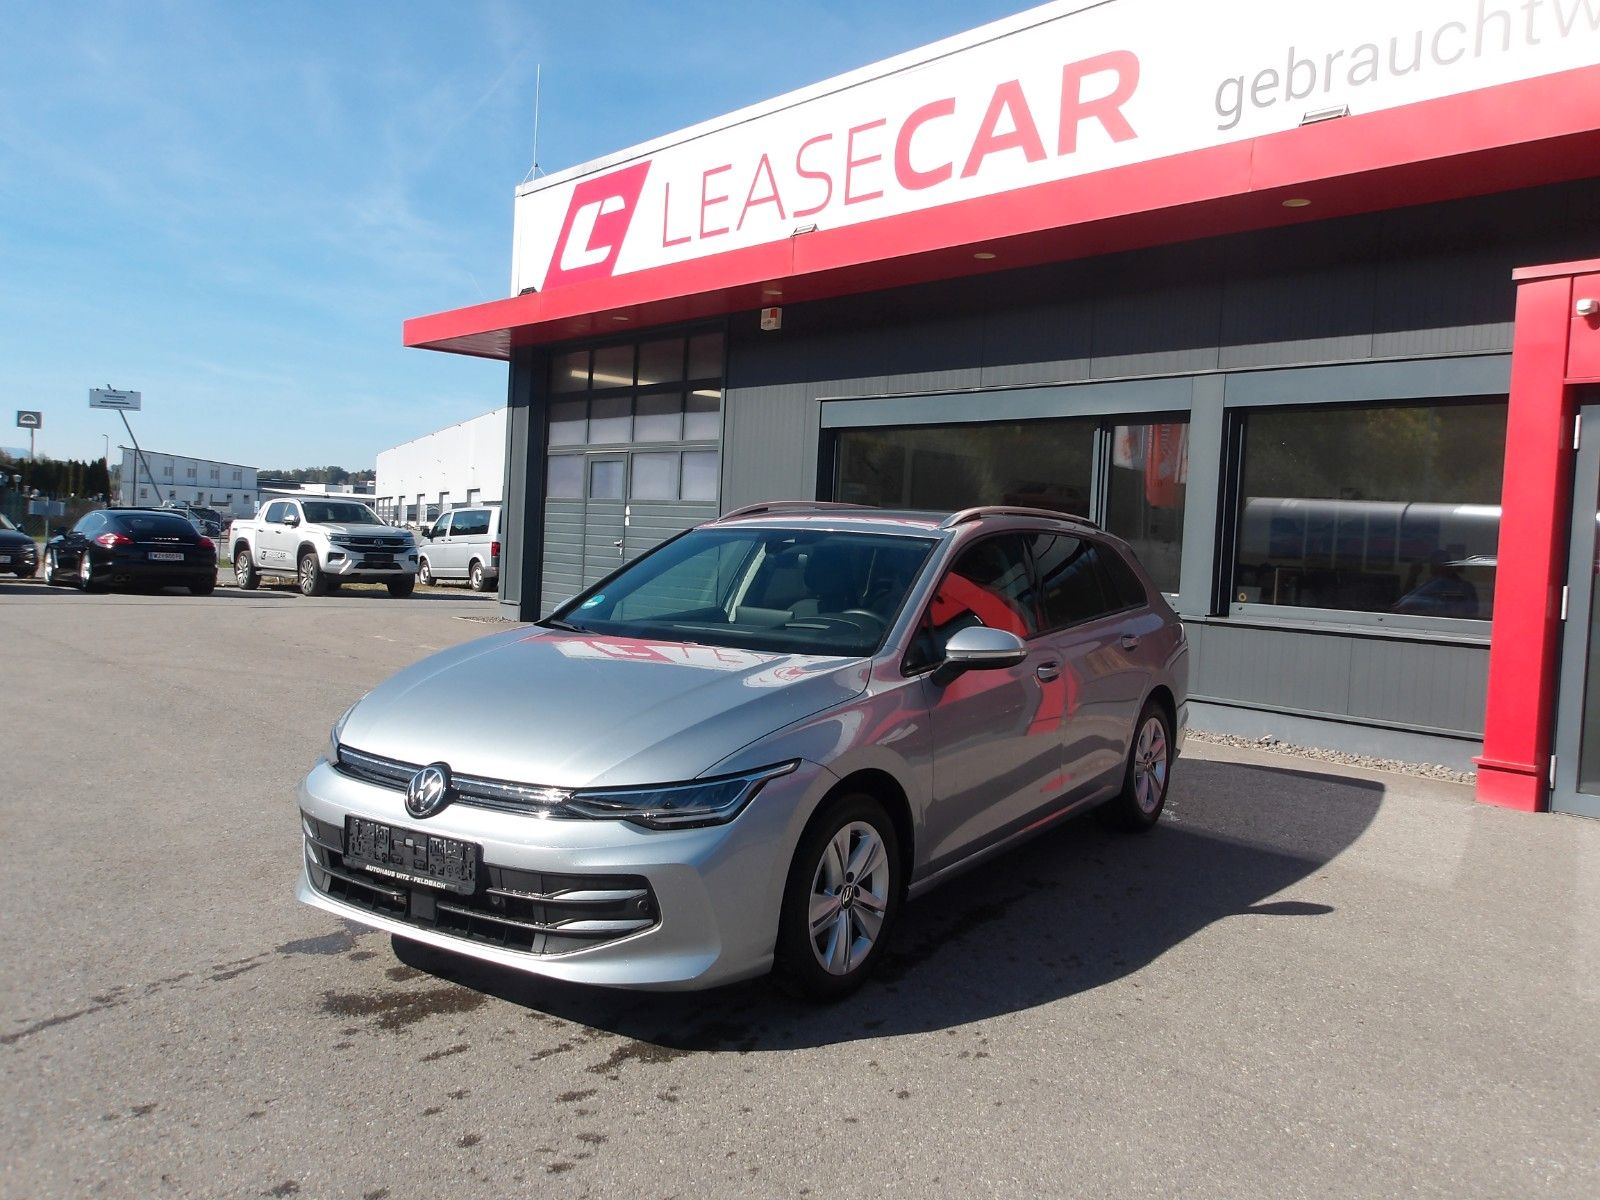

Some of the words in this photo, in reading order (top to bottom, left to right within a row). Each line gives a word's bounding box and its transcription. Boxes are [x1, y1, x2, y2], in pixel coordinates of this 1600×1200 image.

[663, 50, 1140, 248] LEASECAR
[365, 864, 395, 878] AUTOHAUS
[413, 876, 446, 890] FELDBACH
